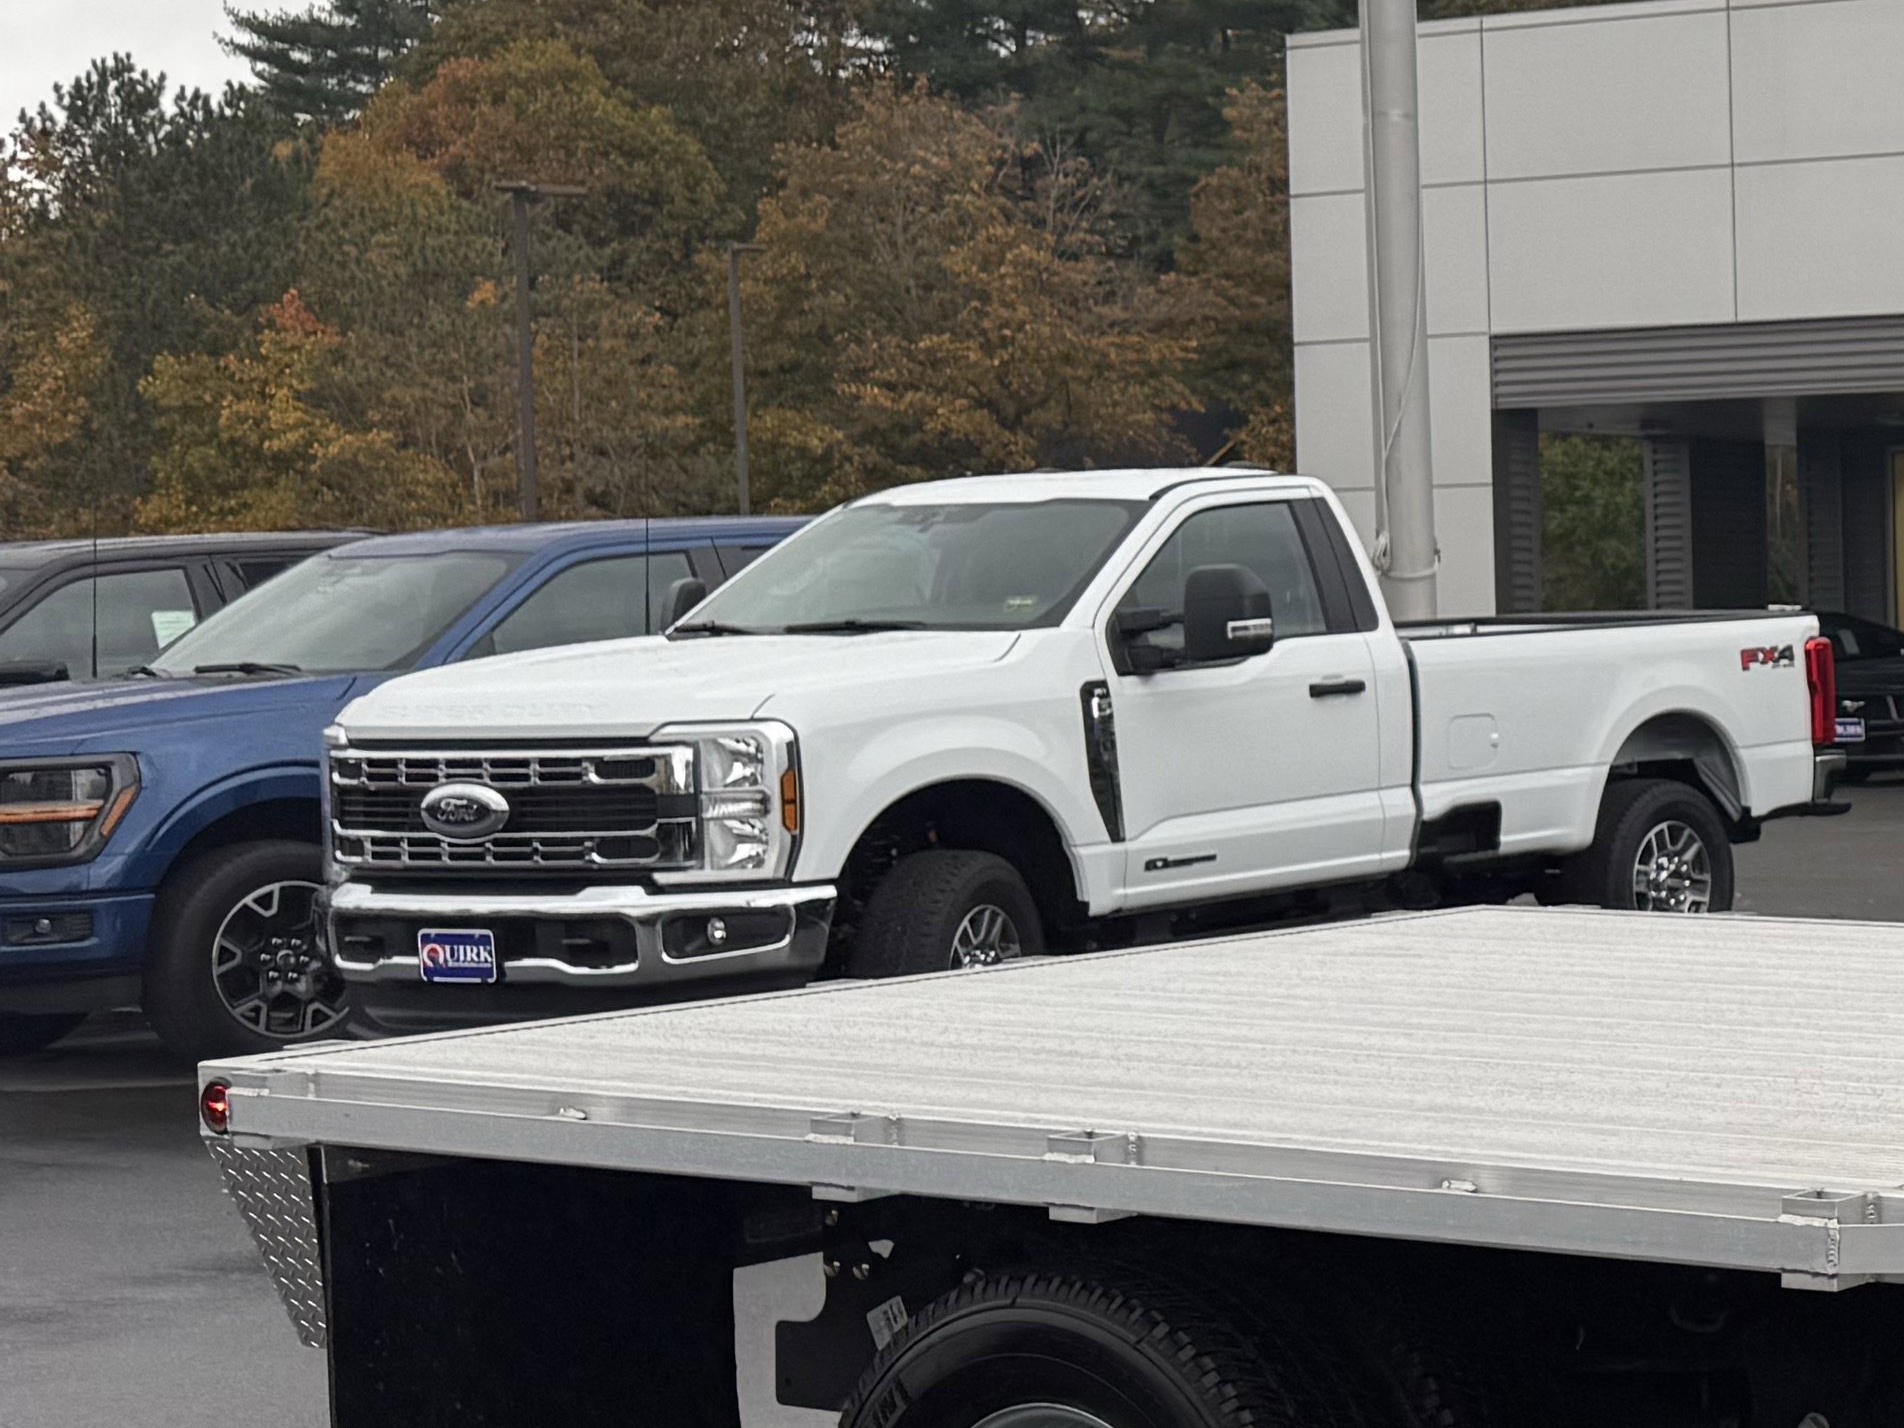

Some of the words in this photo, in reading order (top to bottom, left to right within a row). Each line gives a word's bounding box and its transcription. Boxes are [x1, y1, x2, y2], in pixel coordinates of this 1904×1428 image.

[1740, 645, 1795, 671] FX4
[436, 797, 479, 822] Ford
[422, 943, 492, 968] QUIRK
